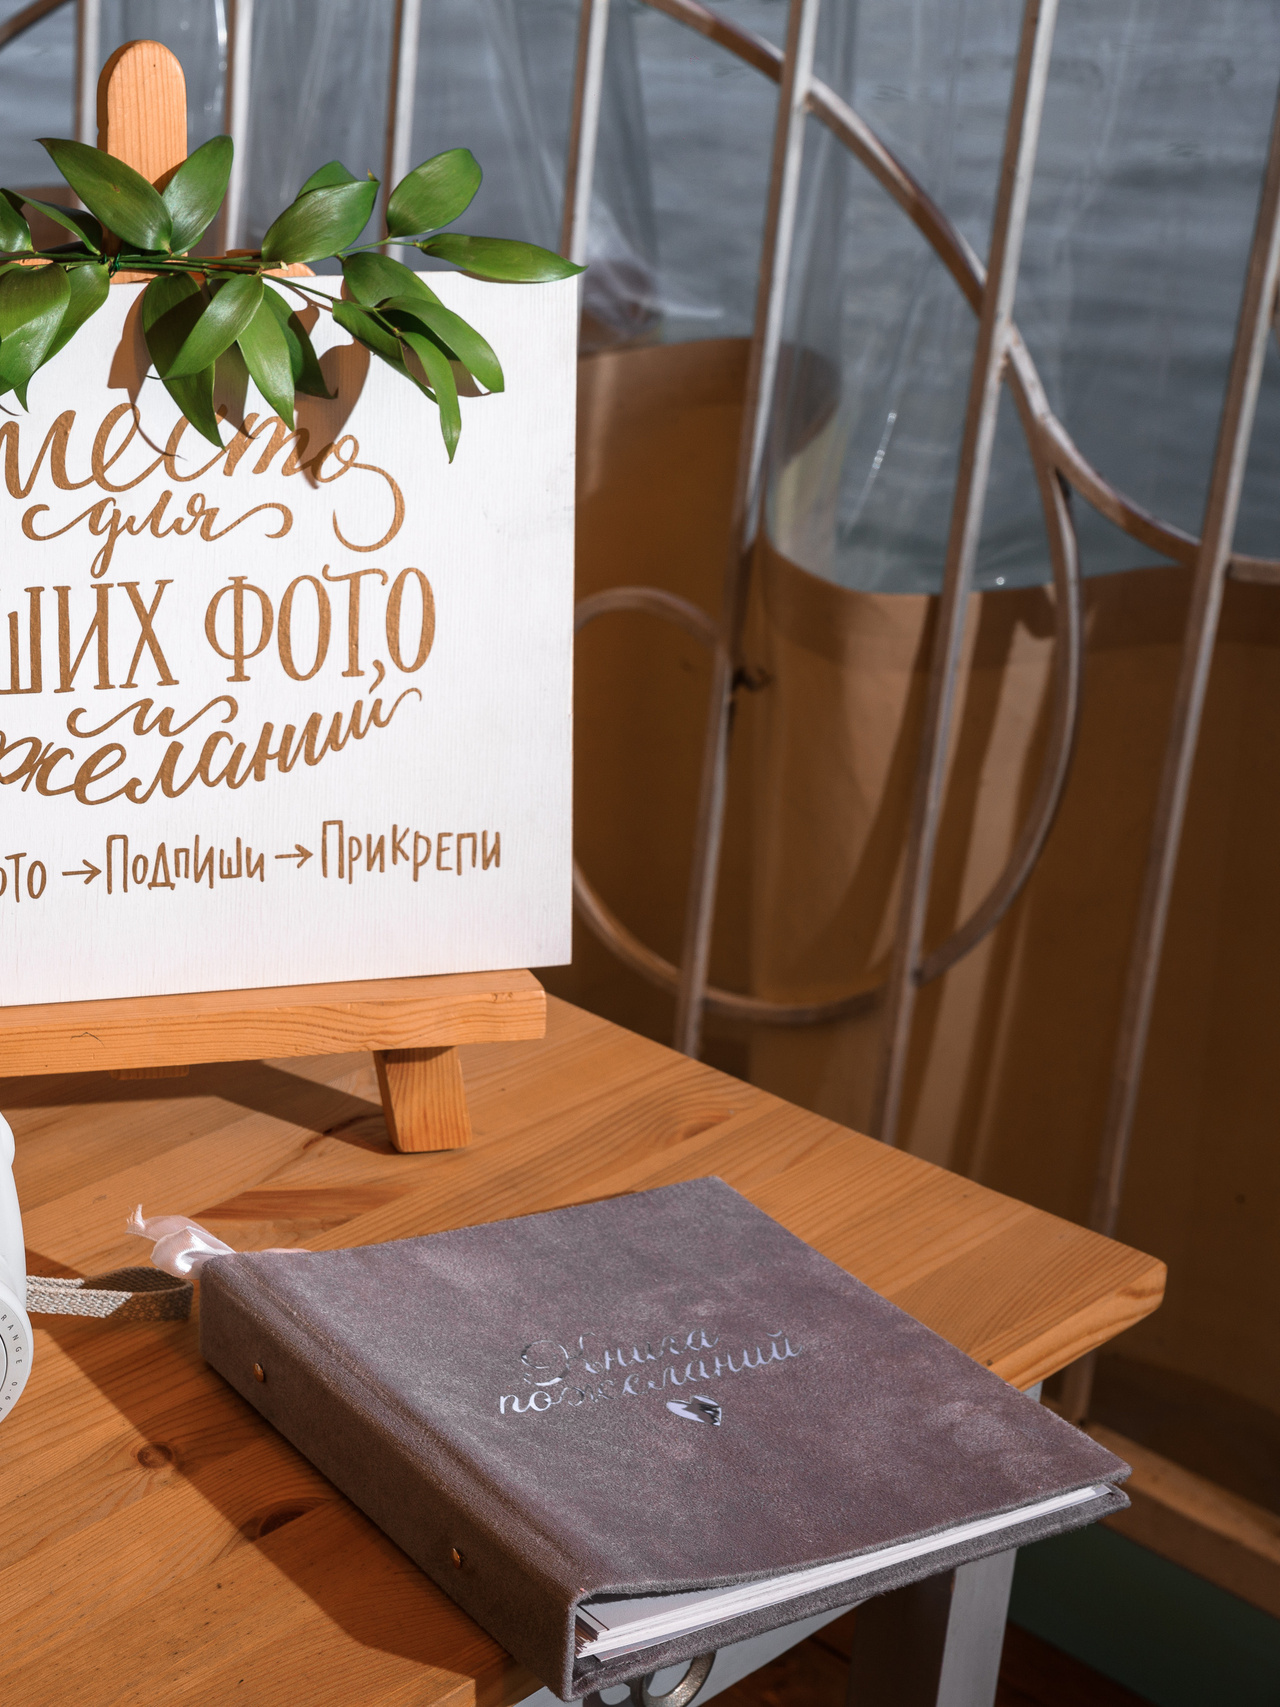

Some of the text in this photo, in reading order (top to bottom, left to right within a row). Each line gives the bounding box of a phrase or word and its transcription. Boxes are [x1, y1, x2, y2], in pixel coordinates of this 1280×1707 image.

[22, 490, 294, 579] для
[204, 563, 437, 683] ФОТО
[66, 694, 239, 739] и
[0, 1314, 23, 1364] RANGE
[499, 1330, 803, 1415] пожеланий
